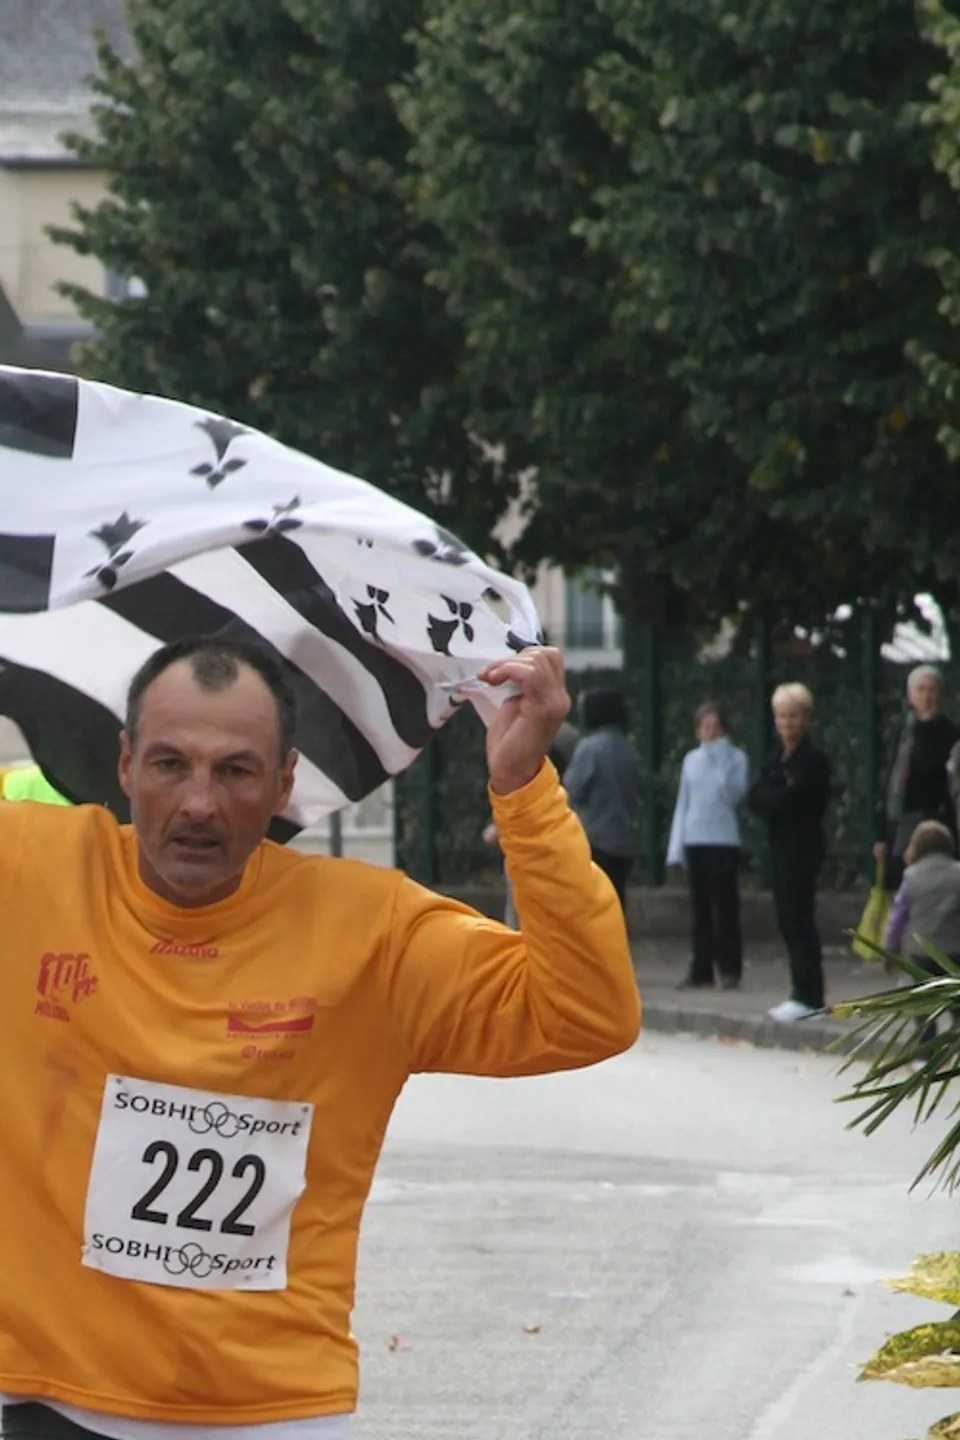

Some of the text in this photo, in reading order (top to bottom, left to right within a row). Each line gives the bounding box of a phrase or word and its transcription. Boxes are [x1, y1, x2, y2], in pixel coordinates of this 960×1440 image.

[114, 1092, 301, 1137] SOBHI Sport
[131, 1140, 266, 1237] 222
[92, 1233, 277, 1275] SOBHI Sport
